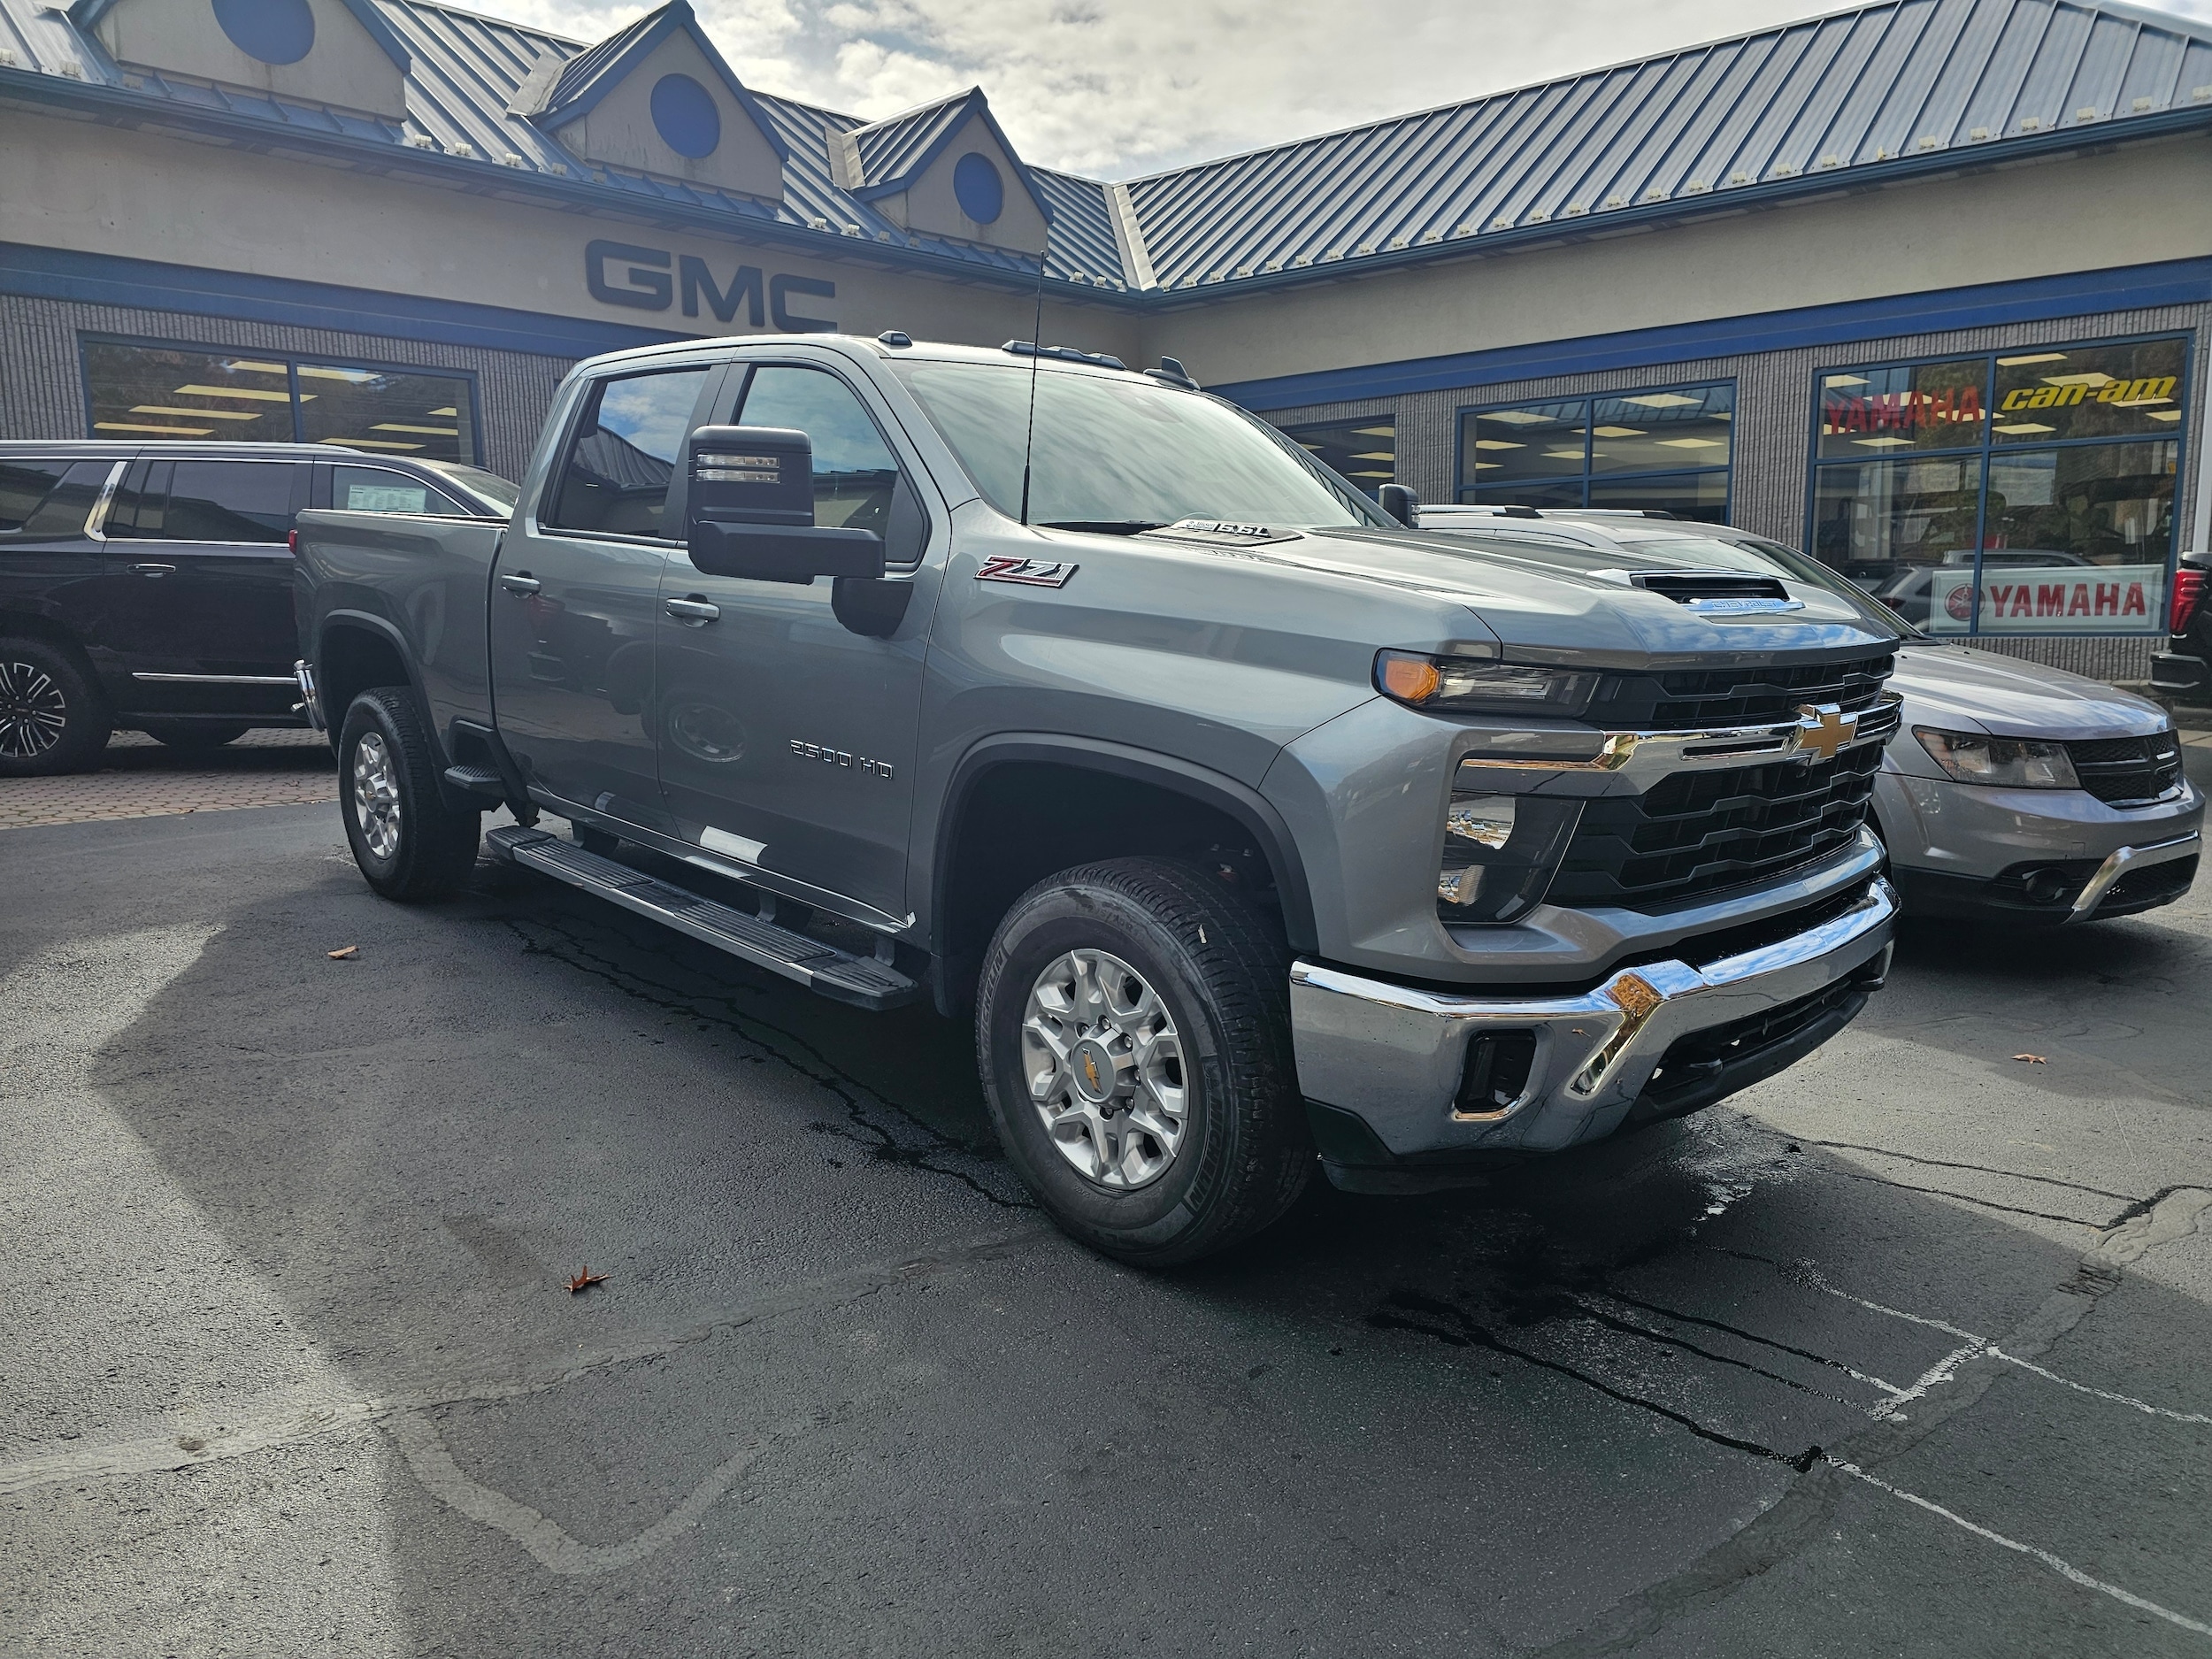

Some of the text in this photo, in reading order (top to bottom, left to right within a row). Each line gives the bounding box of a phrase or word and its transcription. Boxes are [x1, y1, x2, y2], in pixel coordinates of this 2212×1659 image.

[585, 238, 838, 334] GMC
[1825, 386, 1980, 435] YAMAHA
[2001, 375, 2177, 411] can-am
[973, 555, 1079, 588] Z71
[1990, 582, 2147, 618] YAMAHA
[790, 739, 894, 780] 2500 HD
[1188, 1095, 1223, 1210] MICHELIN
